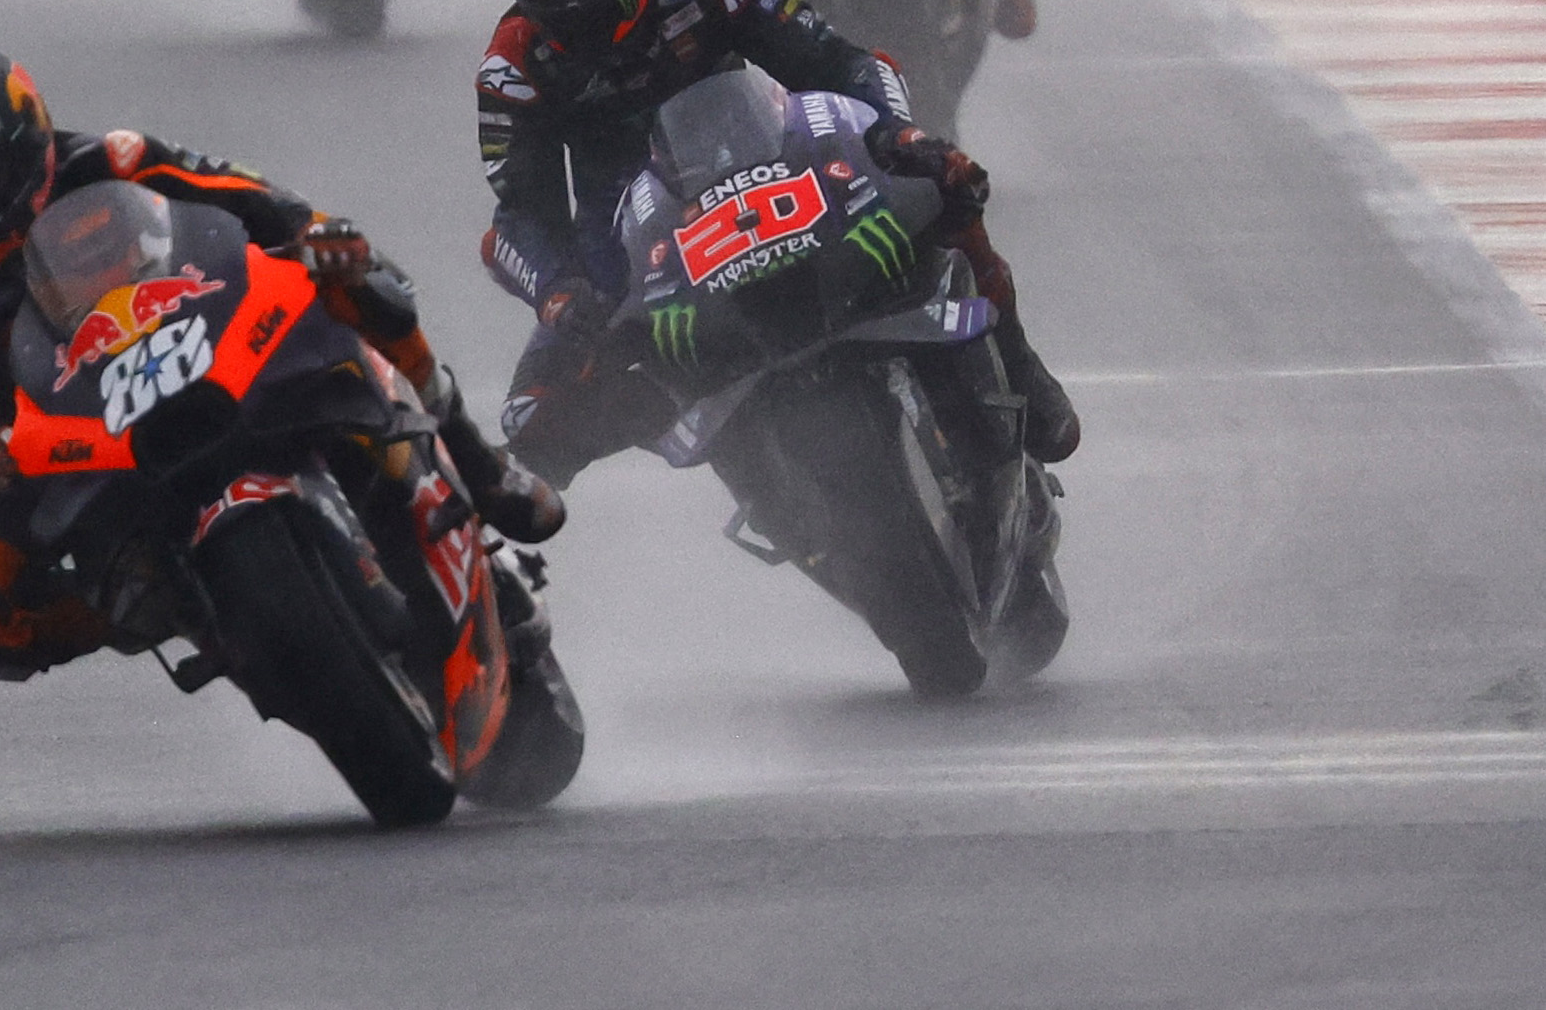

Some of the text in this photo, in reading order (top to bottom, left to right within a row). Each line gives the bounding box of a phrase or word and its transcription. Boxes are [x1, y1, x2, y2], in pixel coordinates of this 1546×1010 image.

[699, 162, 790, 212] ENEOS
[494, 232, 538, 298] YAMAHA
[706, 232, 822, 293] MONSTER
